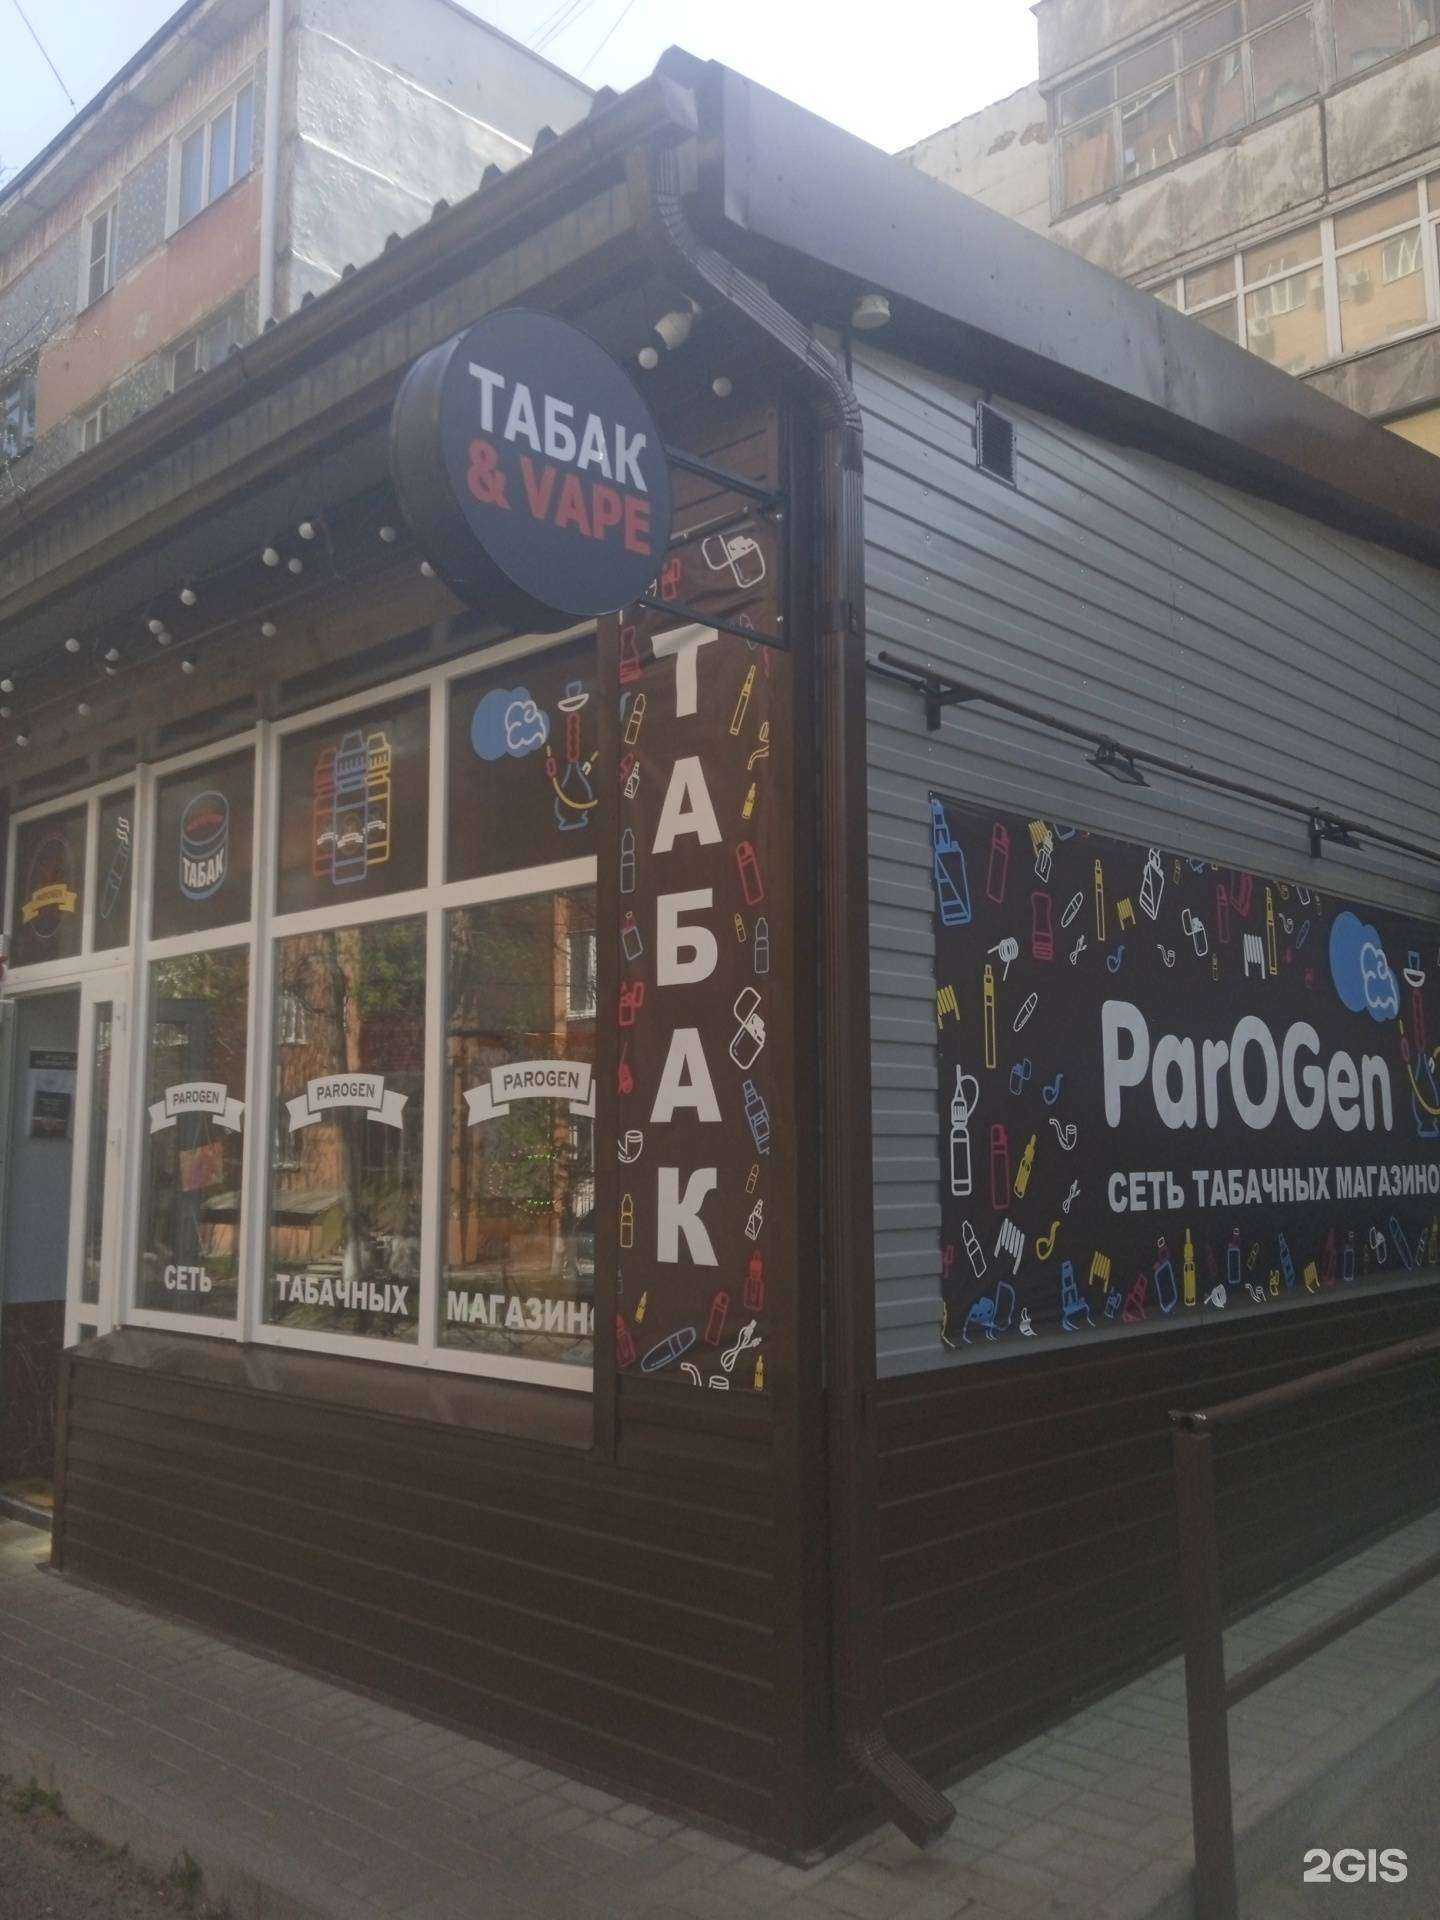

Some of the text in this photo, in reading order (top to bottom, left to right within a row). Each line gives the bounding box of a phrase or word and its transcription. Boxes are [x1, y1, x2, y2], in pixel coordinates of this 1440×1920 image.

[468, 362, 648, 493] ТАБАК
[467, 438, 652, 556] & VAPE
[182, 847, 225, 888] ТАБАК
[651, 622, 722, 1267] ТАБАК
[316, 1083, 376, 1101] PAROGEN
[503, 1070, 581, 1091] PAROGEN
[1101, 1000, 1393, 1131] ParOGen
[173, 1090, 220, 1106] PAROGEN
[1107, 1163, 1440, 1213] СЕТЬ ТАБАЧНЫХ МАГАЗИНО
[164, 1265, 595, 1335] СЕТЬ ТАБАЧНЫХ МАГАЗИН
